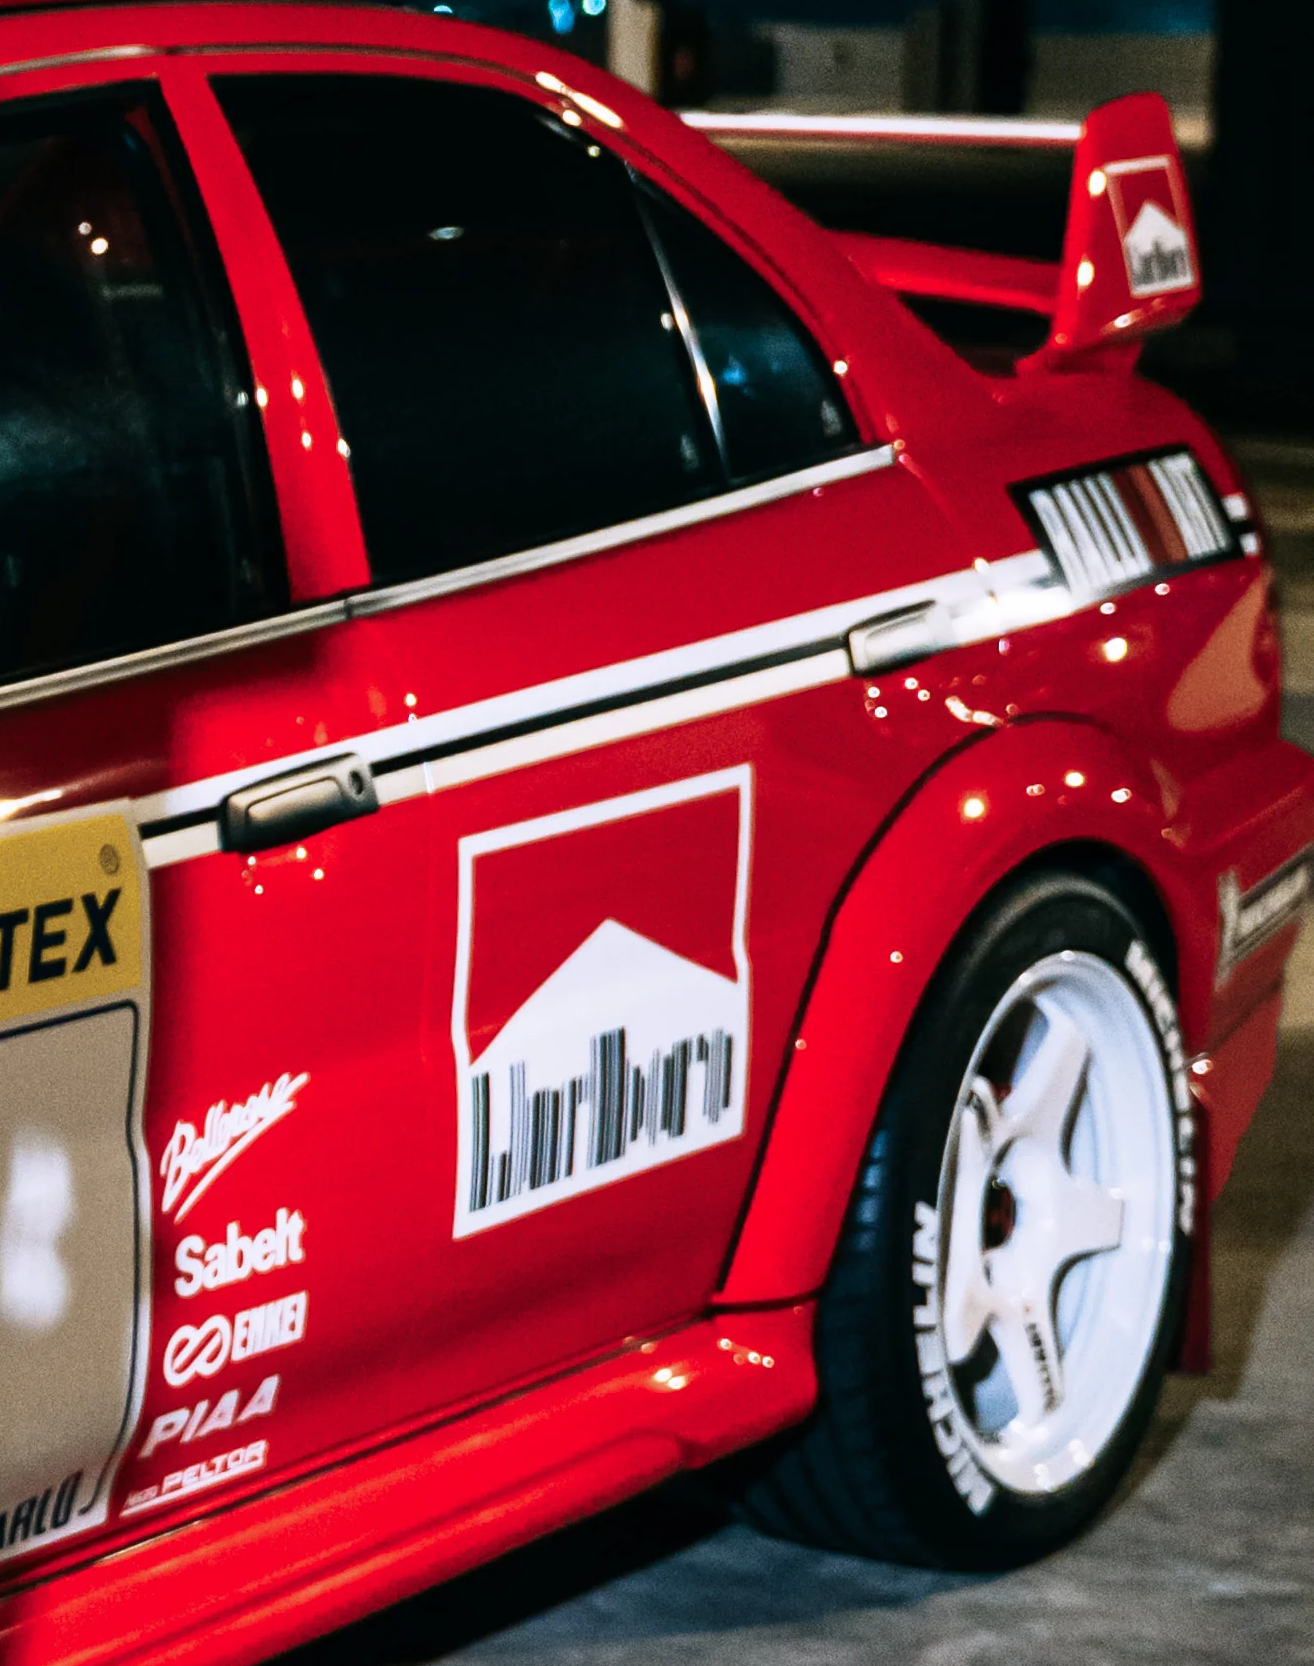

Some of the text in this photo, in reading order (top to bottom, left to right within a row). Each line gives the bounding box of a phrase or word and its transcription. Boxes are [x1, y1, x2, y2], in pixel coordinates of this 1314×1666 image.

[174, 1207, 306, 1299] Sabelt
[232, 1291, 308, 1362] ENKEI
[912, 1200, 995, 1517] MICHELIN
[137, 1373, 282, 1460] PIAA
[161, 1438, 269, 1495] PELTOR
